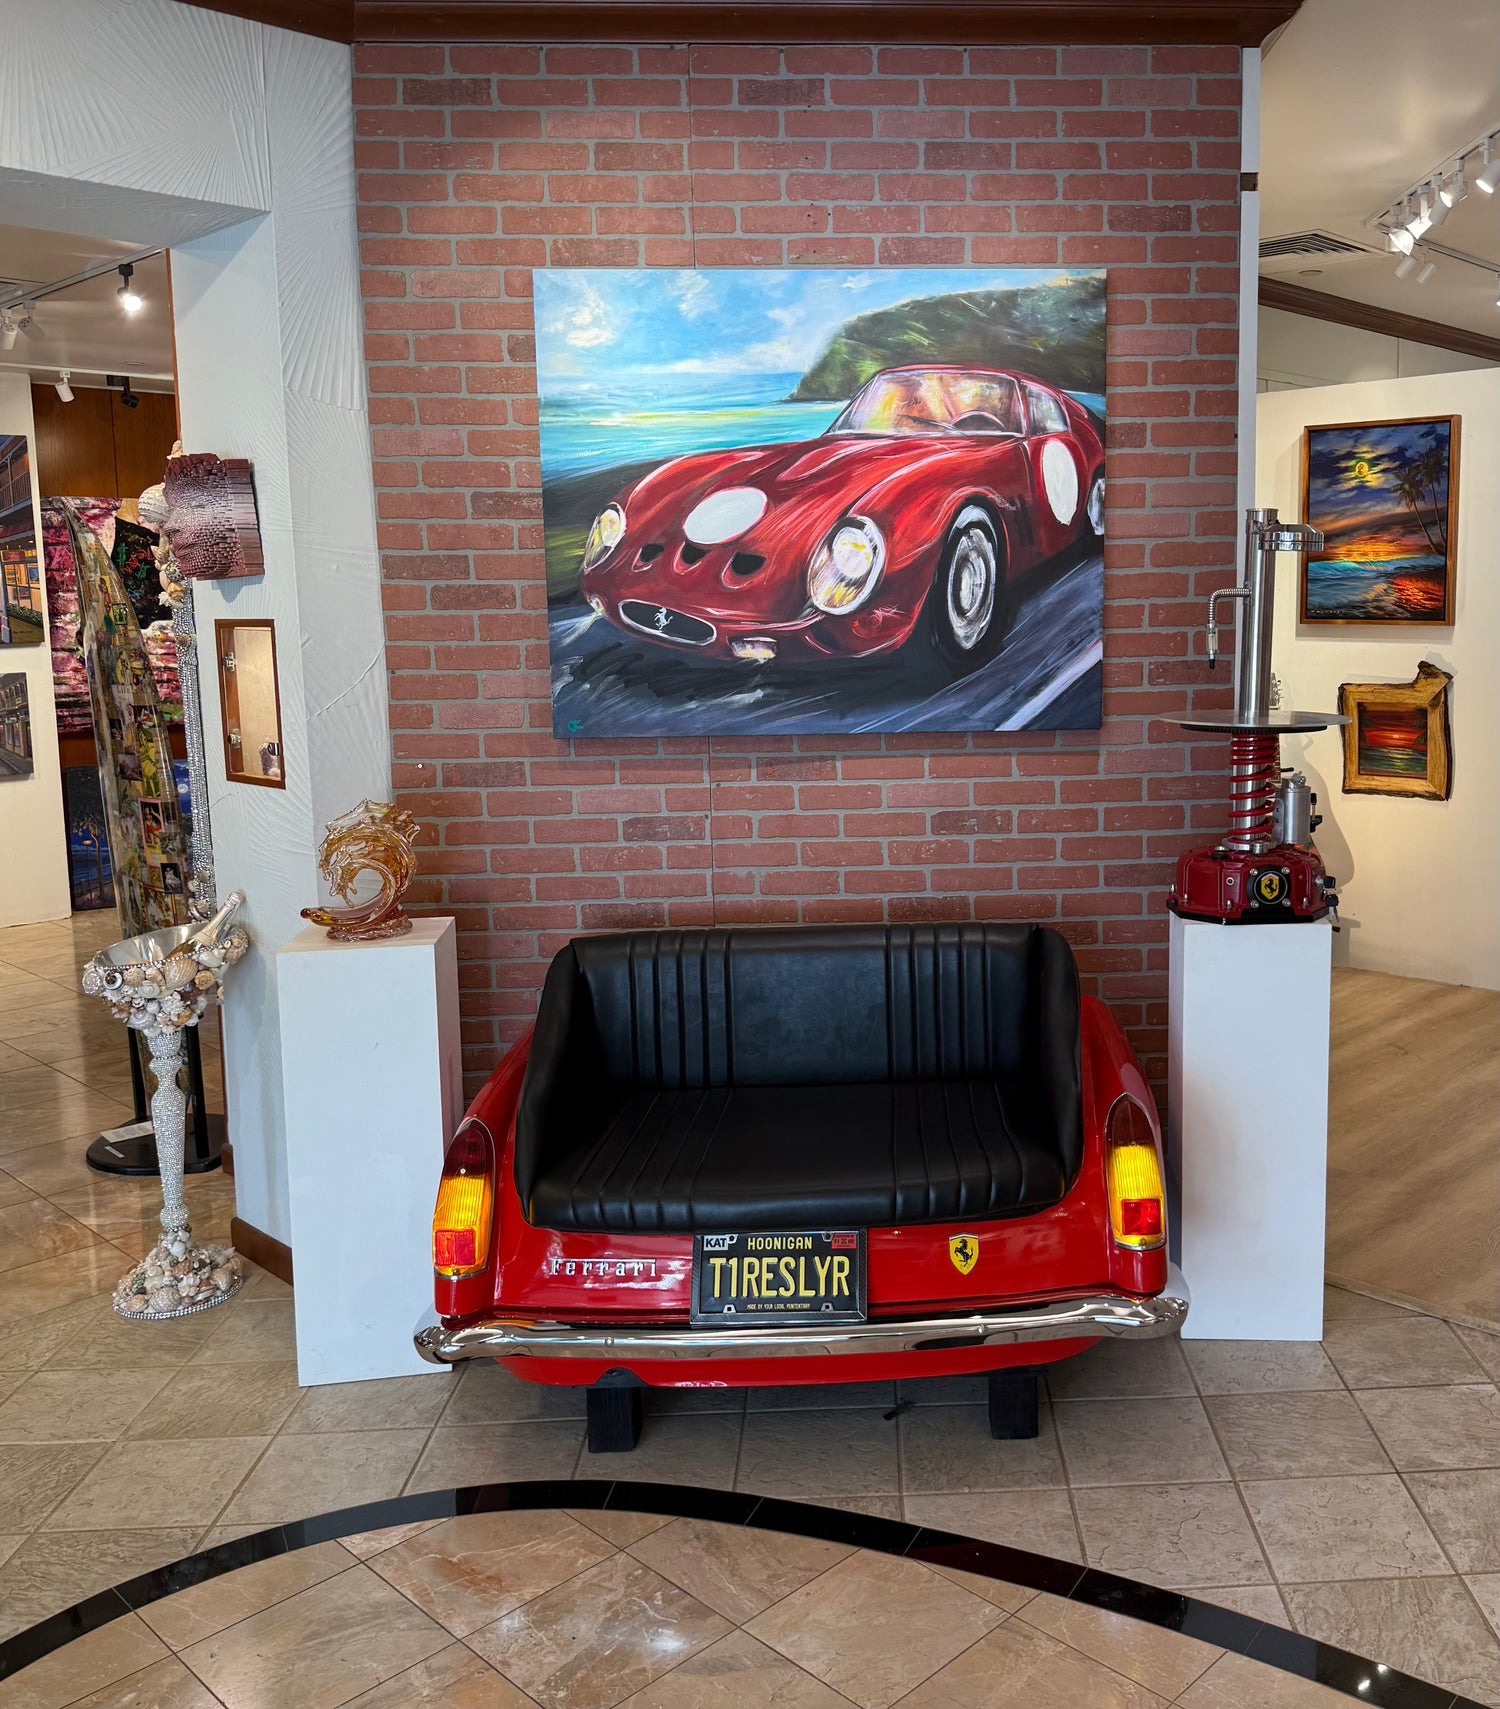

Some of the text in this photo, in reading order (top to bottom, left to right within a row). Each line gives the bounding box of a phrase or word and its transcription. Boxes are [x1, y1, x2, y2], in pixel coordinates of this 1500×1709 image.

[706, 1237, 727, 1248] KAT
[747, 1236, 813, 1250] HOONIGAN
[549, 1257, 656, 1277] Ferrari
